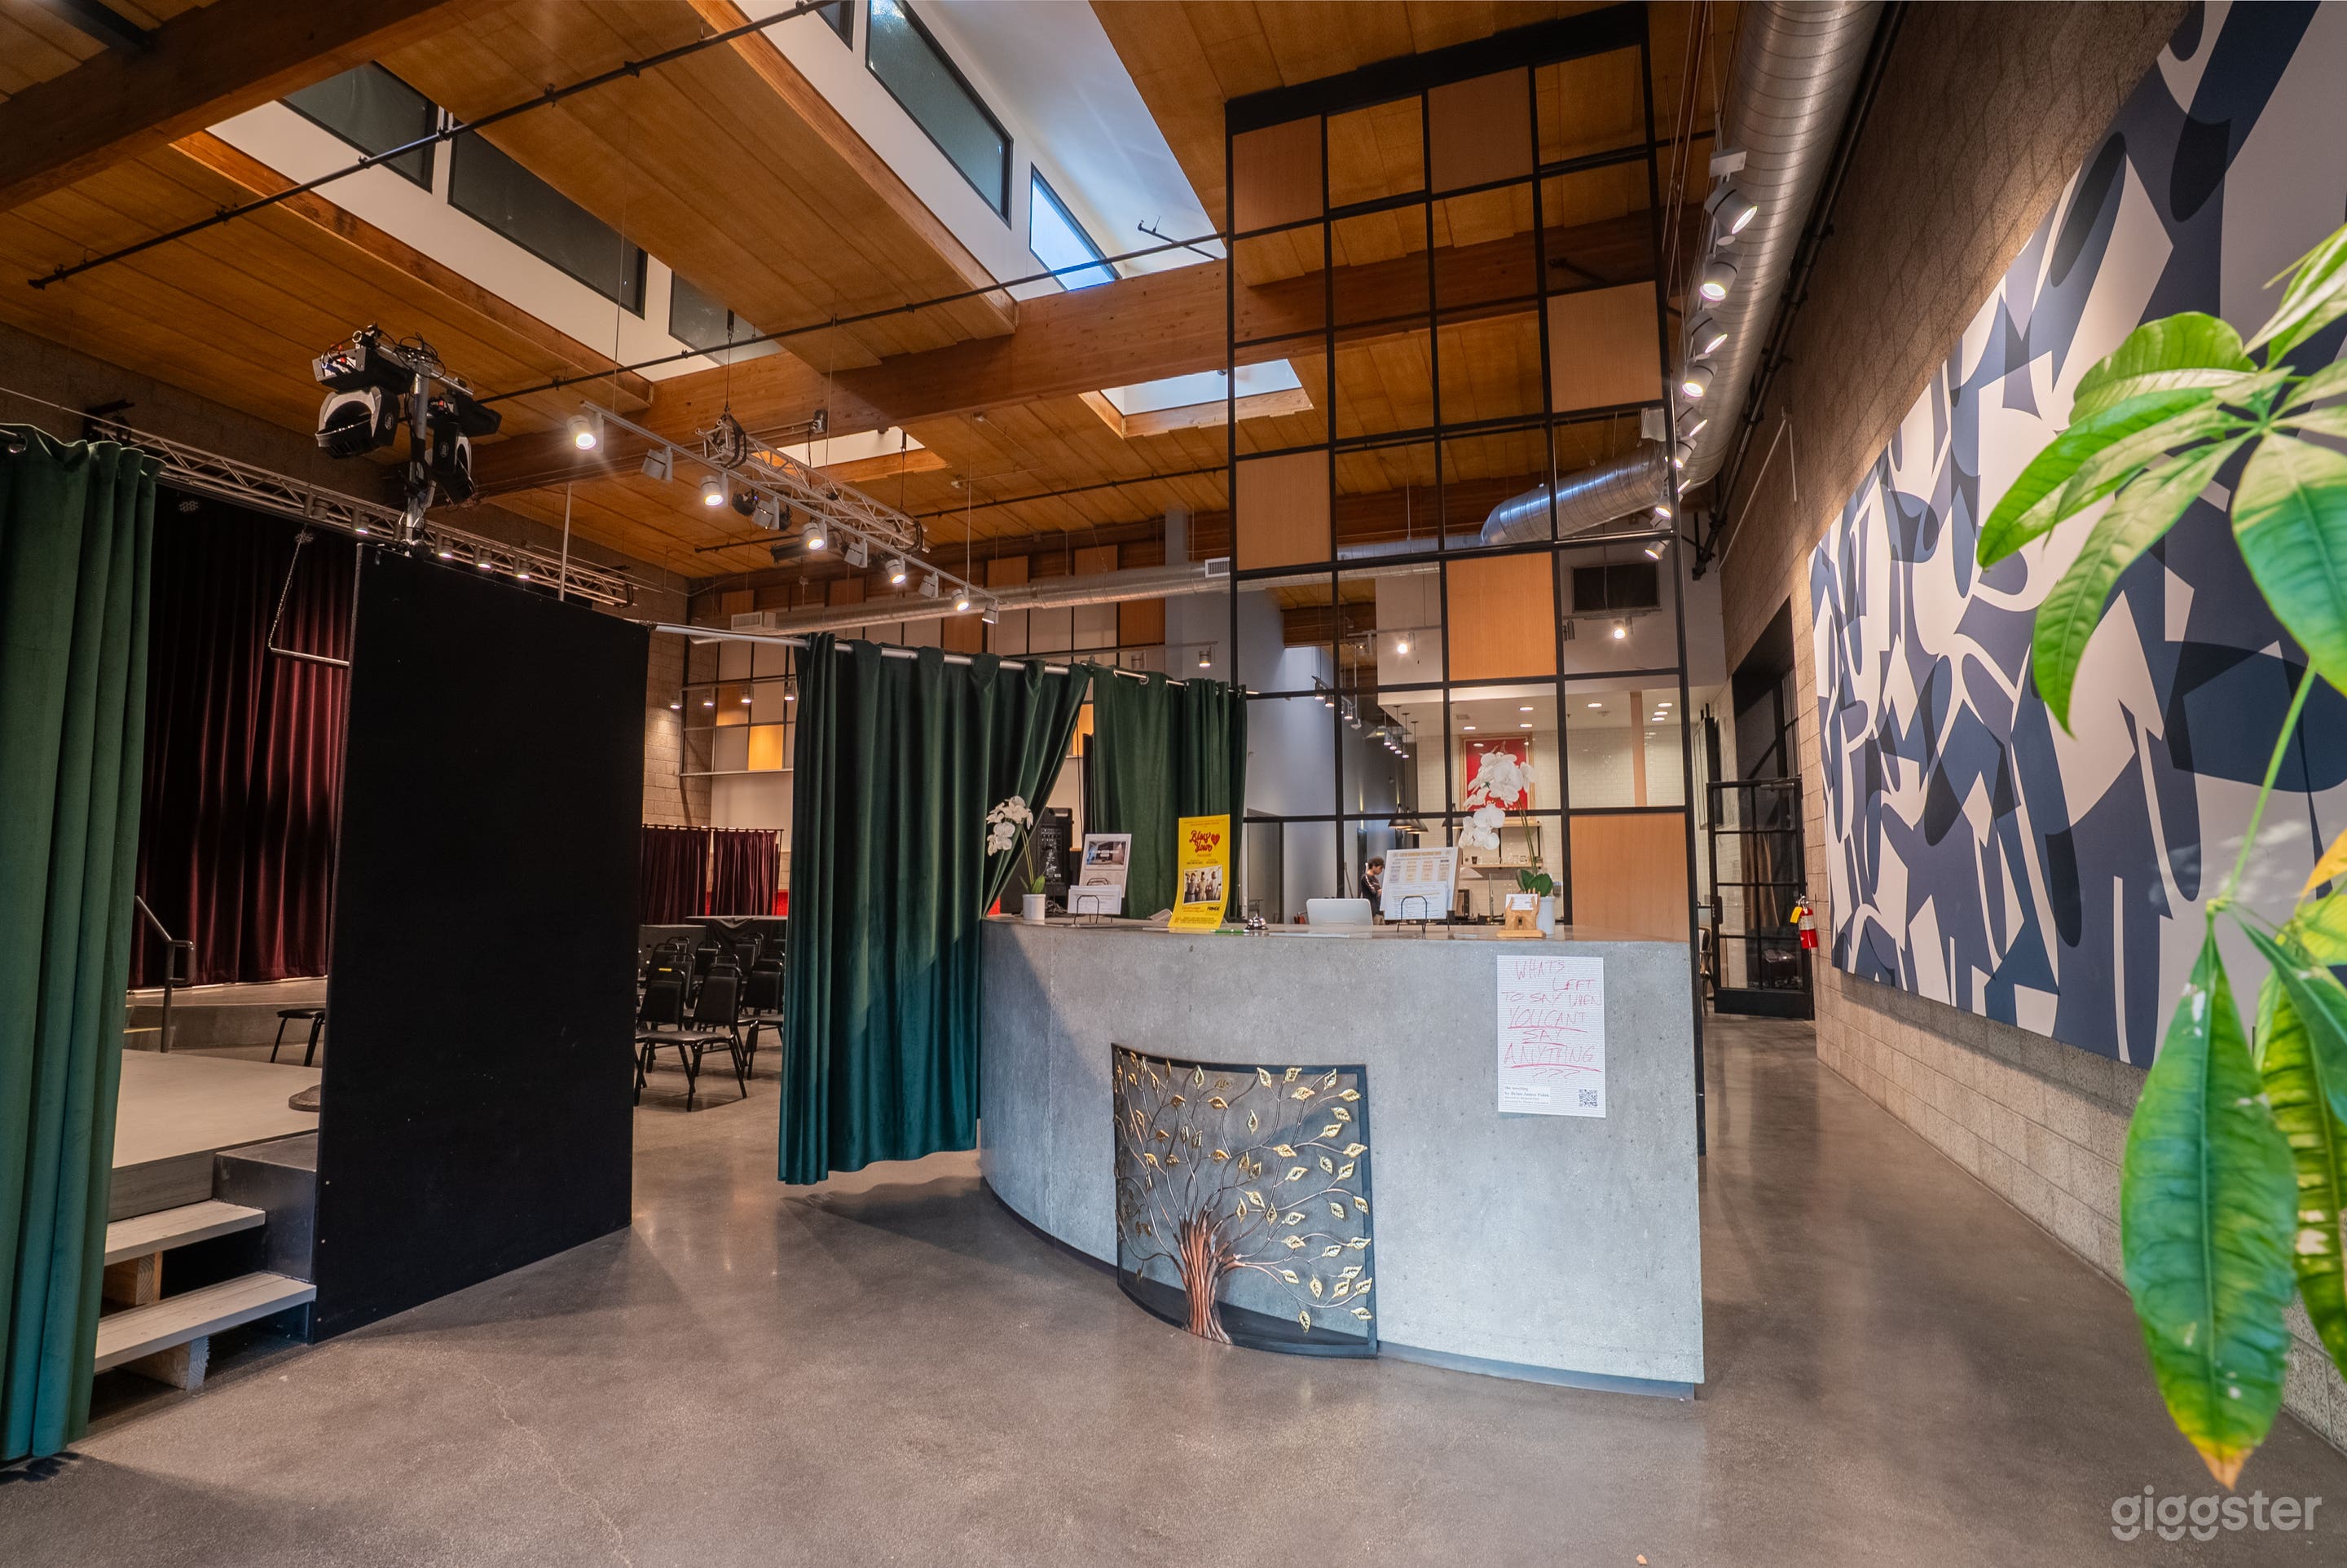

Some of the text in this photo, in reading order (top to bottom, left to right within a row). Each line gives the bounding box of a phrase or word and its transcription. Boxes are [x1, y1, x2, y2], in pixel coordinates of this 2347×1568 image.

[1552, 976, 1596, 991] LEFT
[1501, 991, 1602, 1007] TO SAY WHEN
[1521, 1028, 1562, 1043] SAY
[1504, 1042, 1596, 1064] ANYTHING
